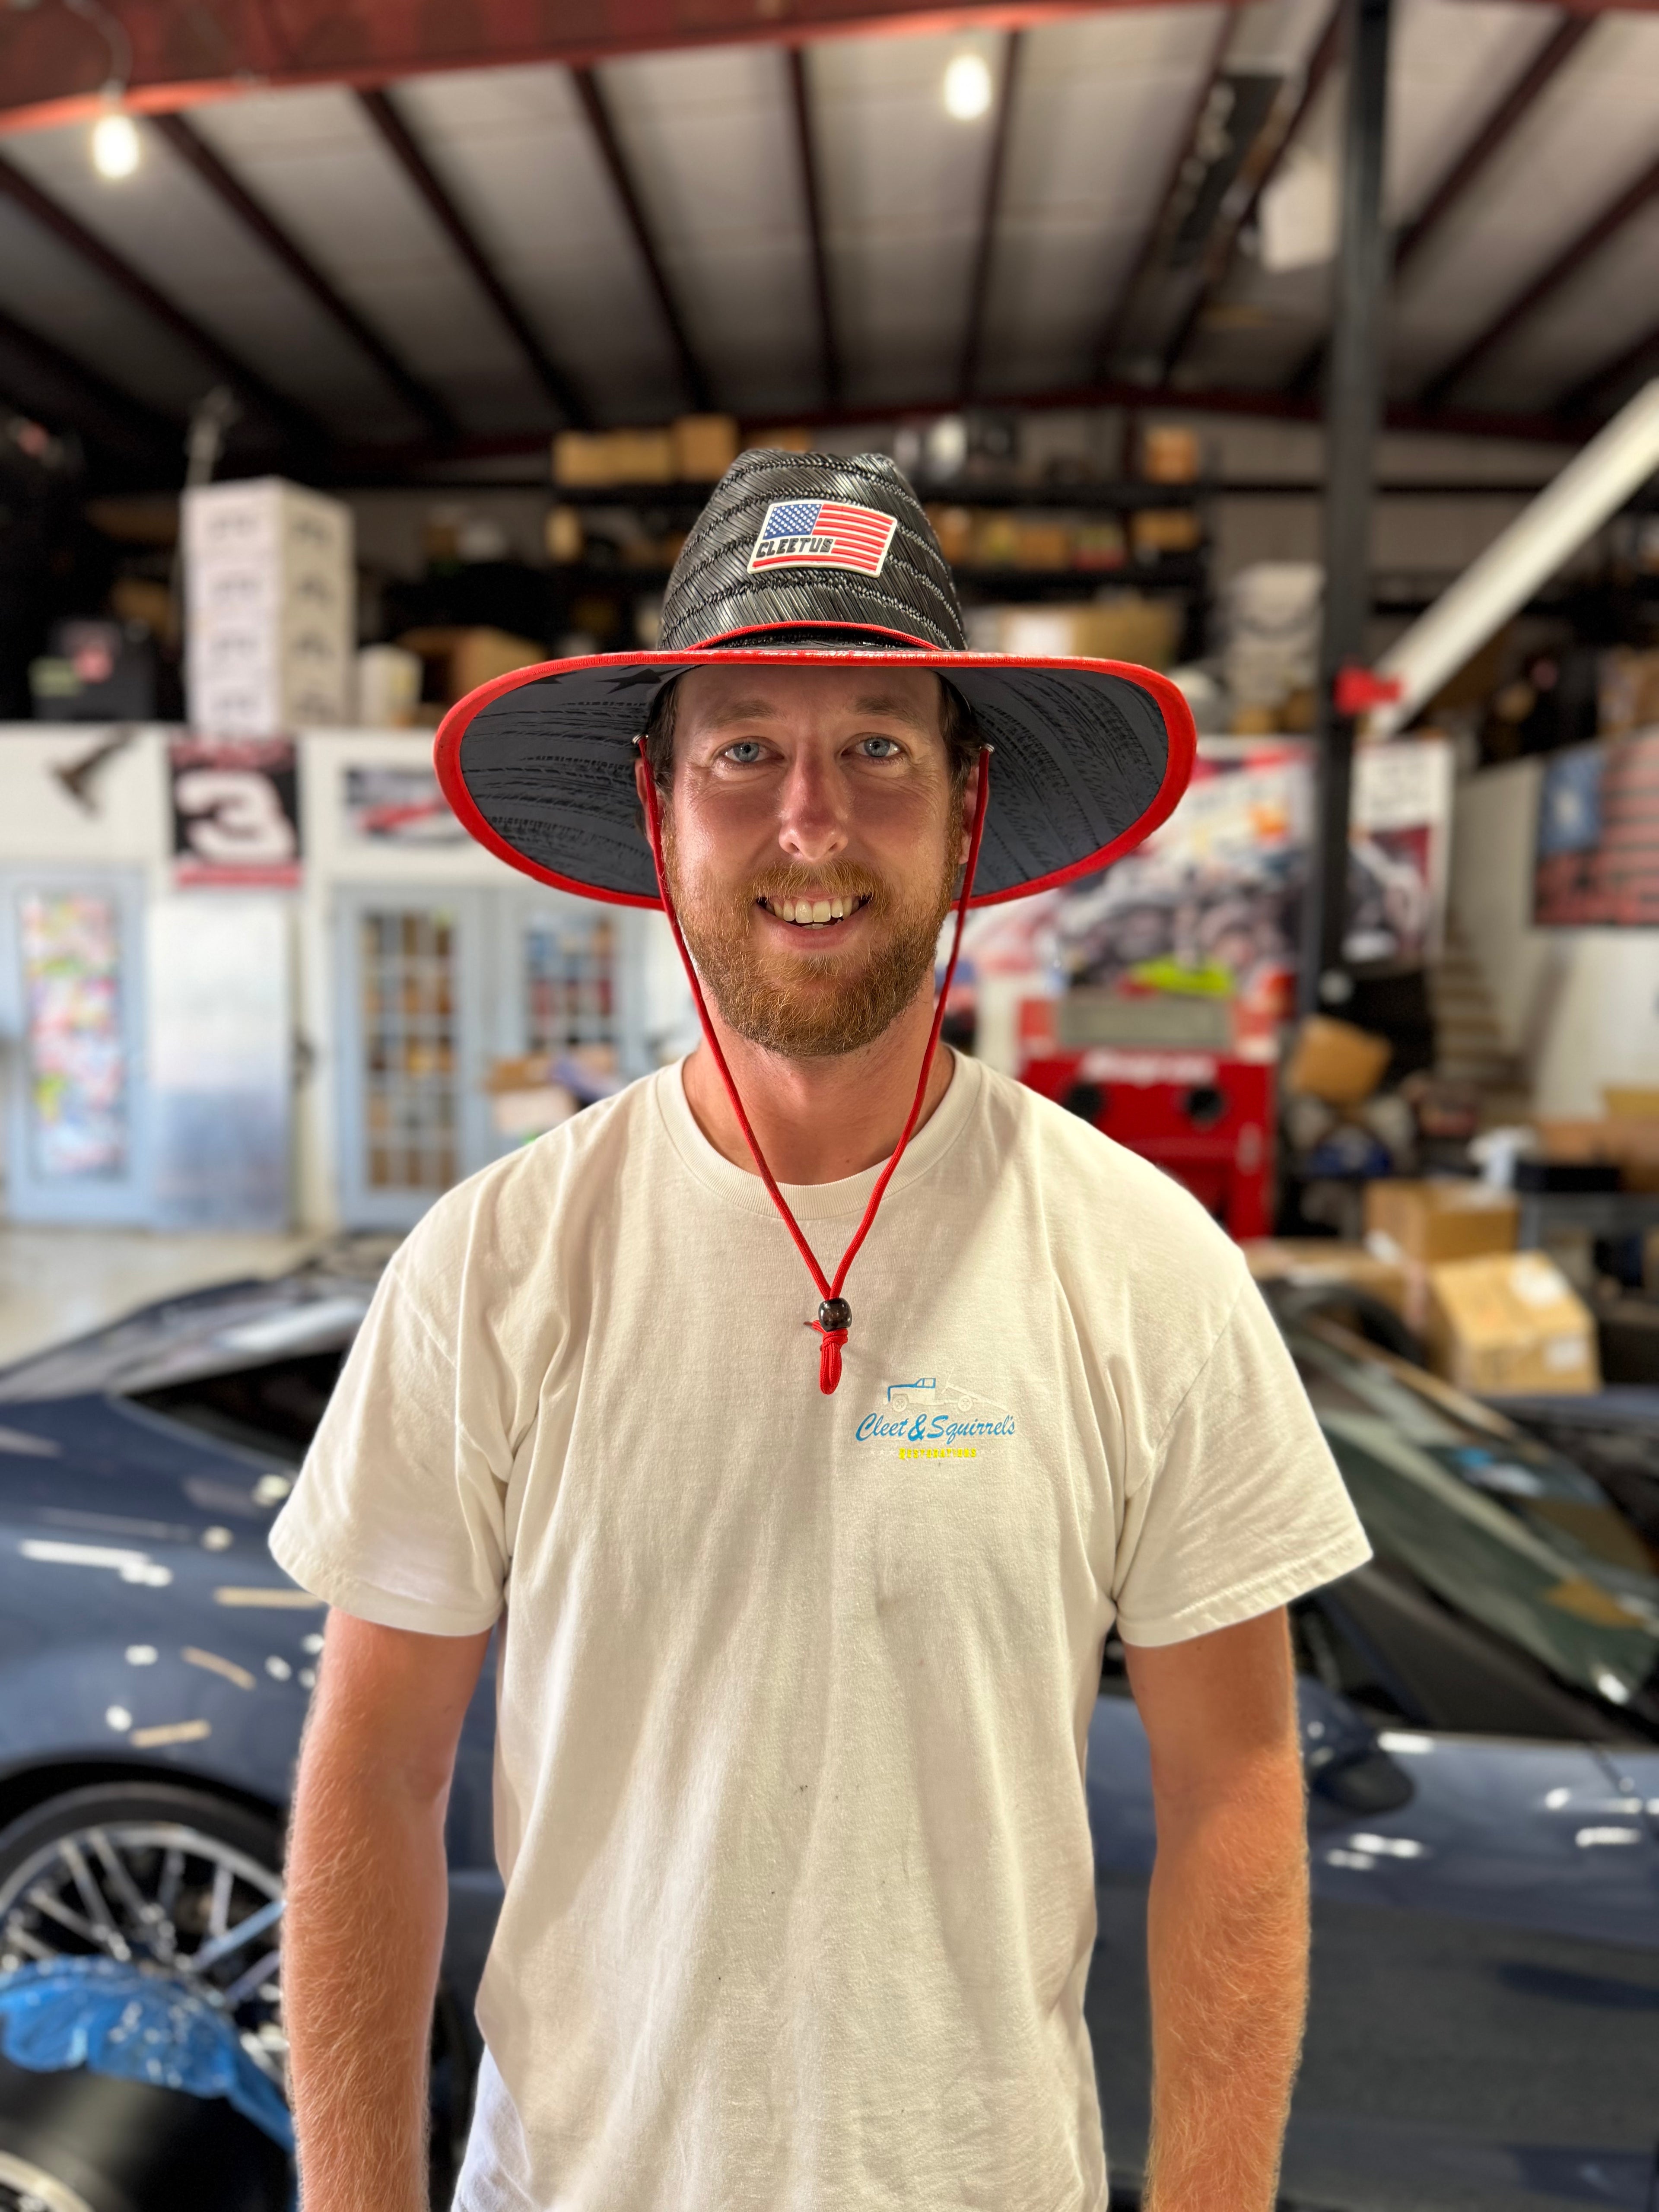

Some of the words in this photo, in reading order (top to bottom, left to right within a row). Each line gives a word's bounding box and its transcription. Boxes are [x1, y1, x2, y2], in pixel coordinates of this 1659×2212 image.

[756, 537, 833, 558] CLEETUS
[175, 771, 298, 862] 3
[855, 1412, 909, 1442] Cleet
[927, 1415, 1015, 1445] Squirrel's
